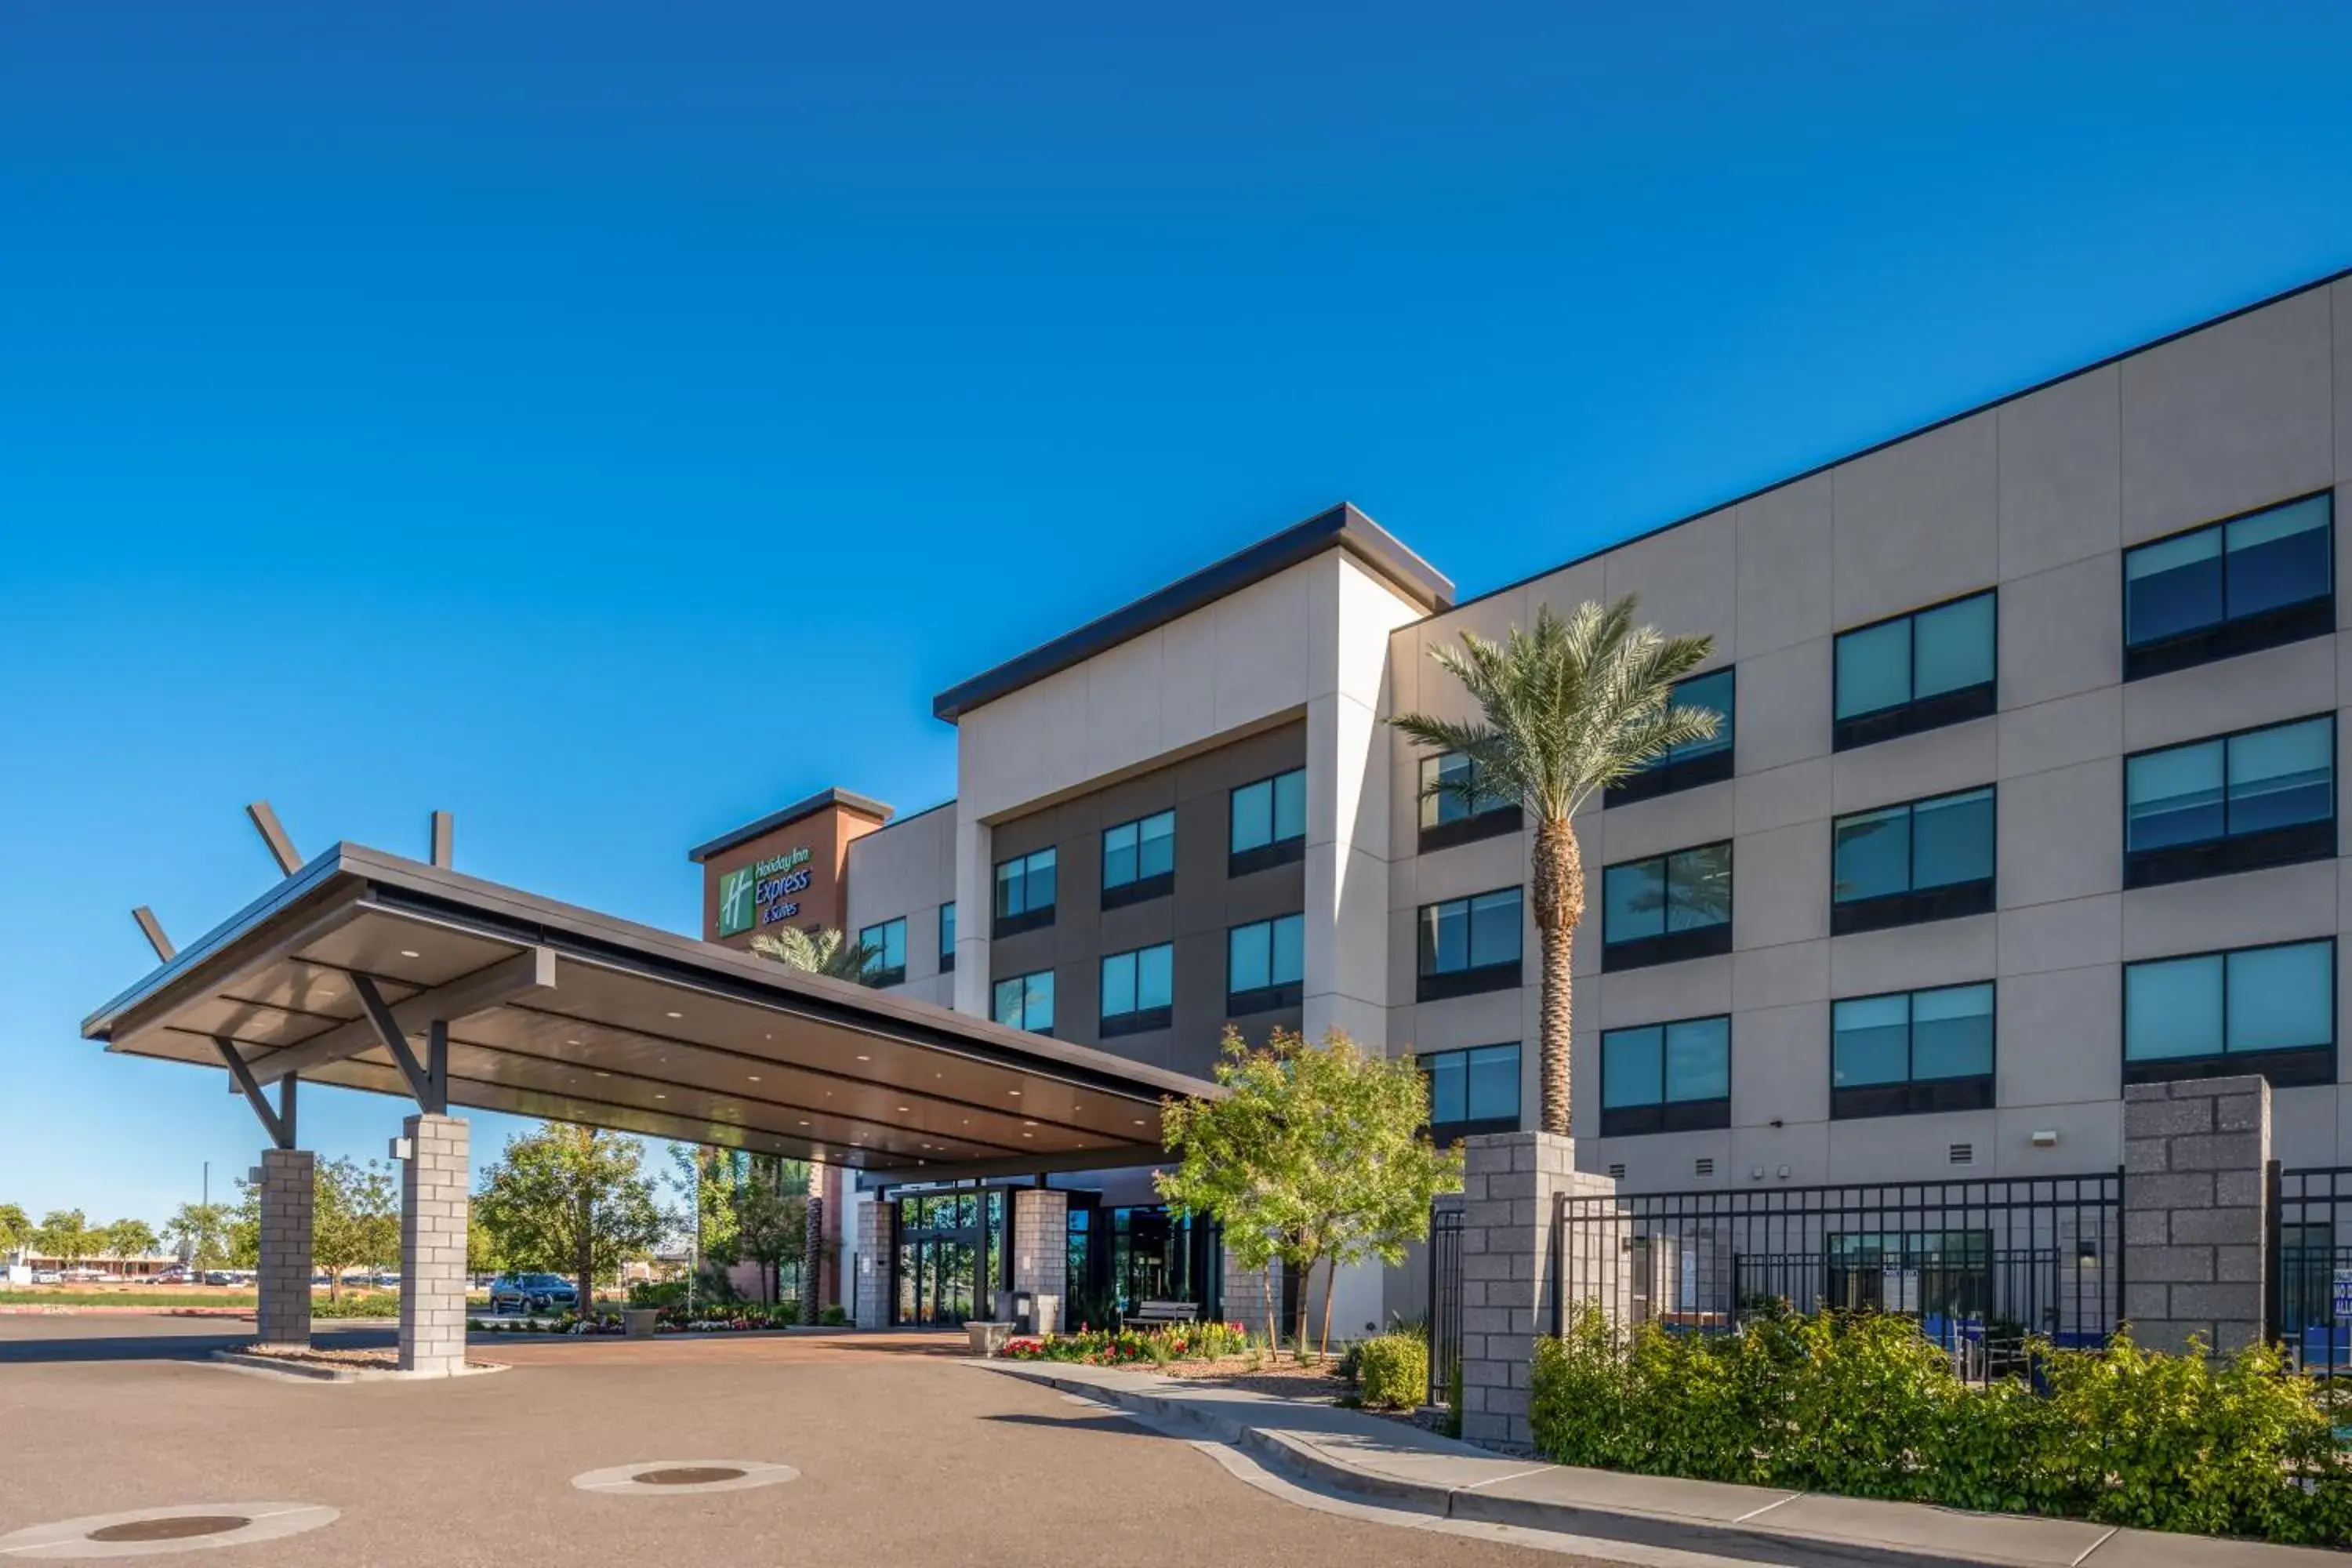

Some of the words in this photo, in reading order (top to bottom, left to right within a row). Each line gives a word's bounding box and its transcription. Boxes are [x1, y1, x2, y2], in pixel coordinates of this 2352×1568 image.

[756, 855, 792, 879] Holiday
[793, 847, 809, 865] Inn
[756, 868, 811, 906] Express
[771, 903, 797, 922] Suites
